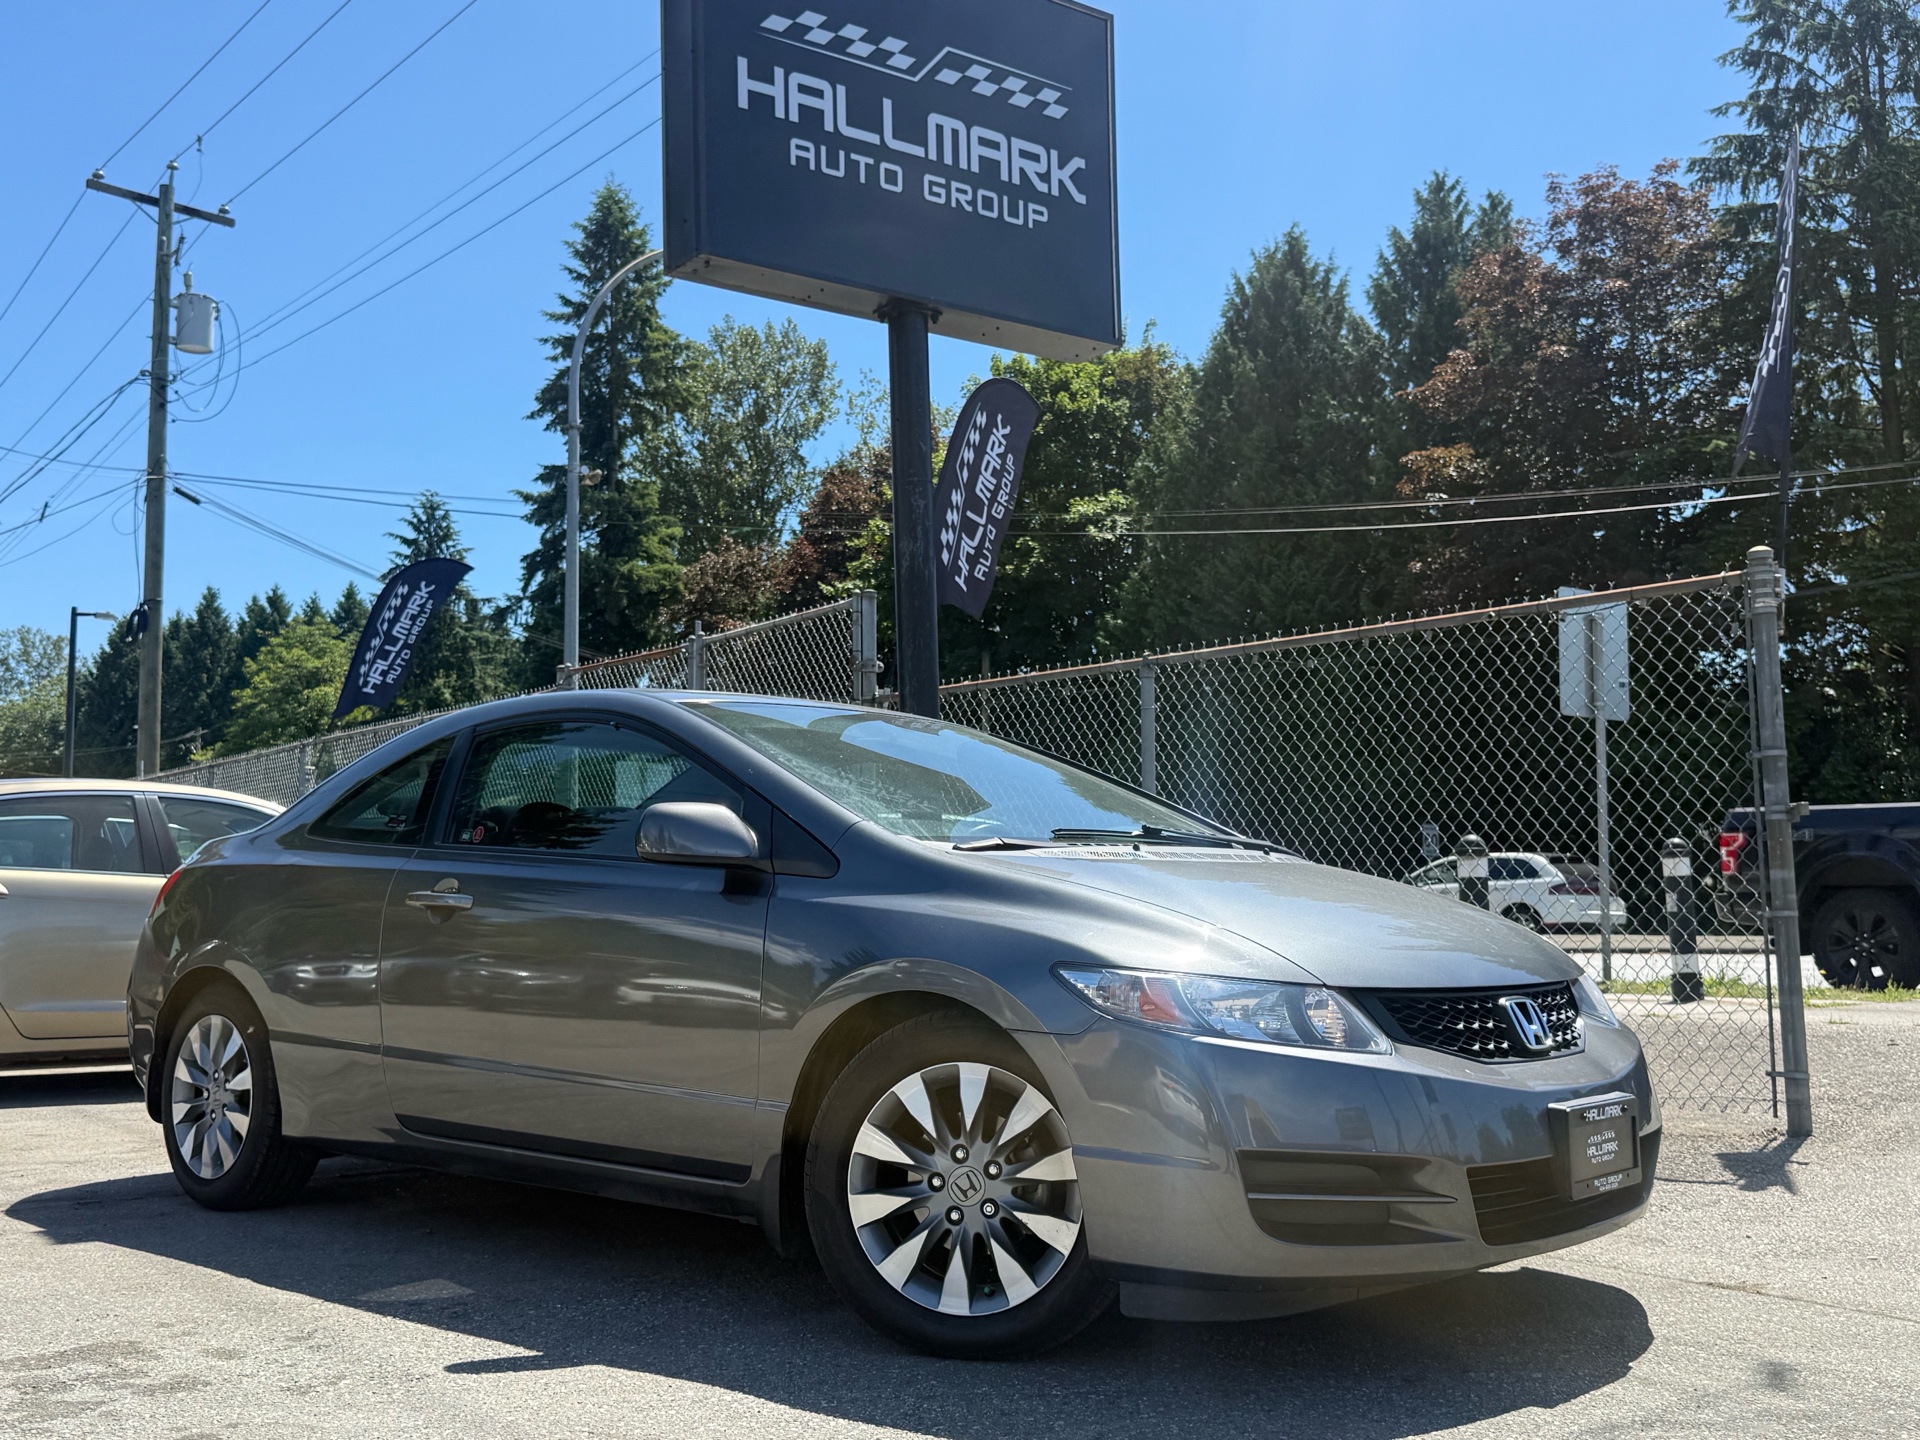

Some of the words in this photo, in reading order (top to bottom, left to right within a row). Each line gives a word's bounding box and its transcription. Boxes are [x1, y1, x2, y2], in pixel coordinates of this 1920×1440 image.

[736, 55, 1087, 205] HALLMARK
[789, 137, 903, 194] AUTO
[922, 173, 1049, 229] GROUP
[954, 413, 1011, 593] HALLMARK
[973, 523, 997, 582] AUTO
[990, 453, 1016, 520] GROUP
[362, 581, 436, 694] HALLMARK
[385, 649, 411, 684] AUTO
[407, 599, 434, 645] GROUP
[1586, 1104, 1622, 1121] HALLMARK
[1587, 1141, 1618, 1157] HALLMARK
[1594, 1178, 1606, 1187] AUTO
[1608, 1174, 1622, 1183] GROUP
